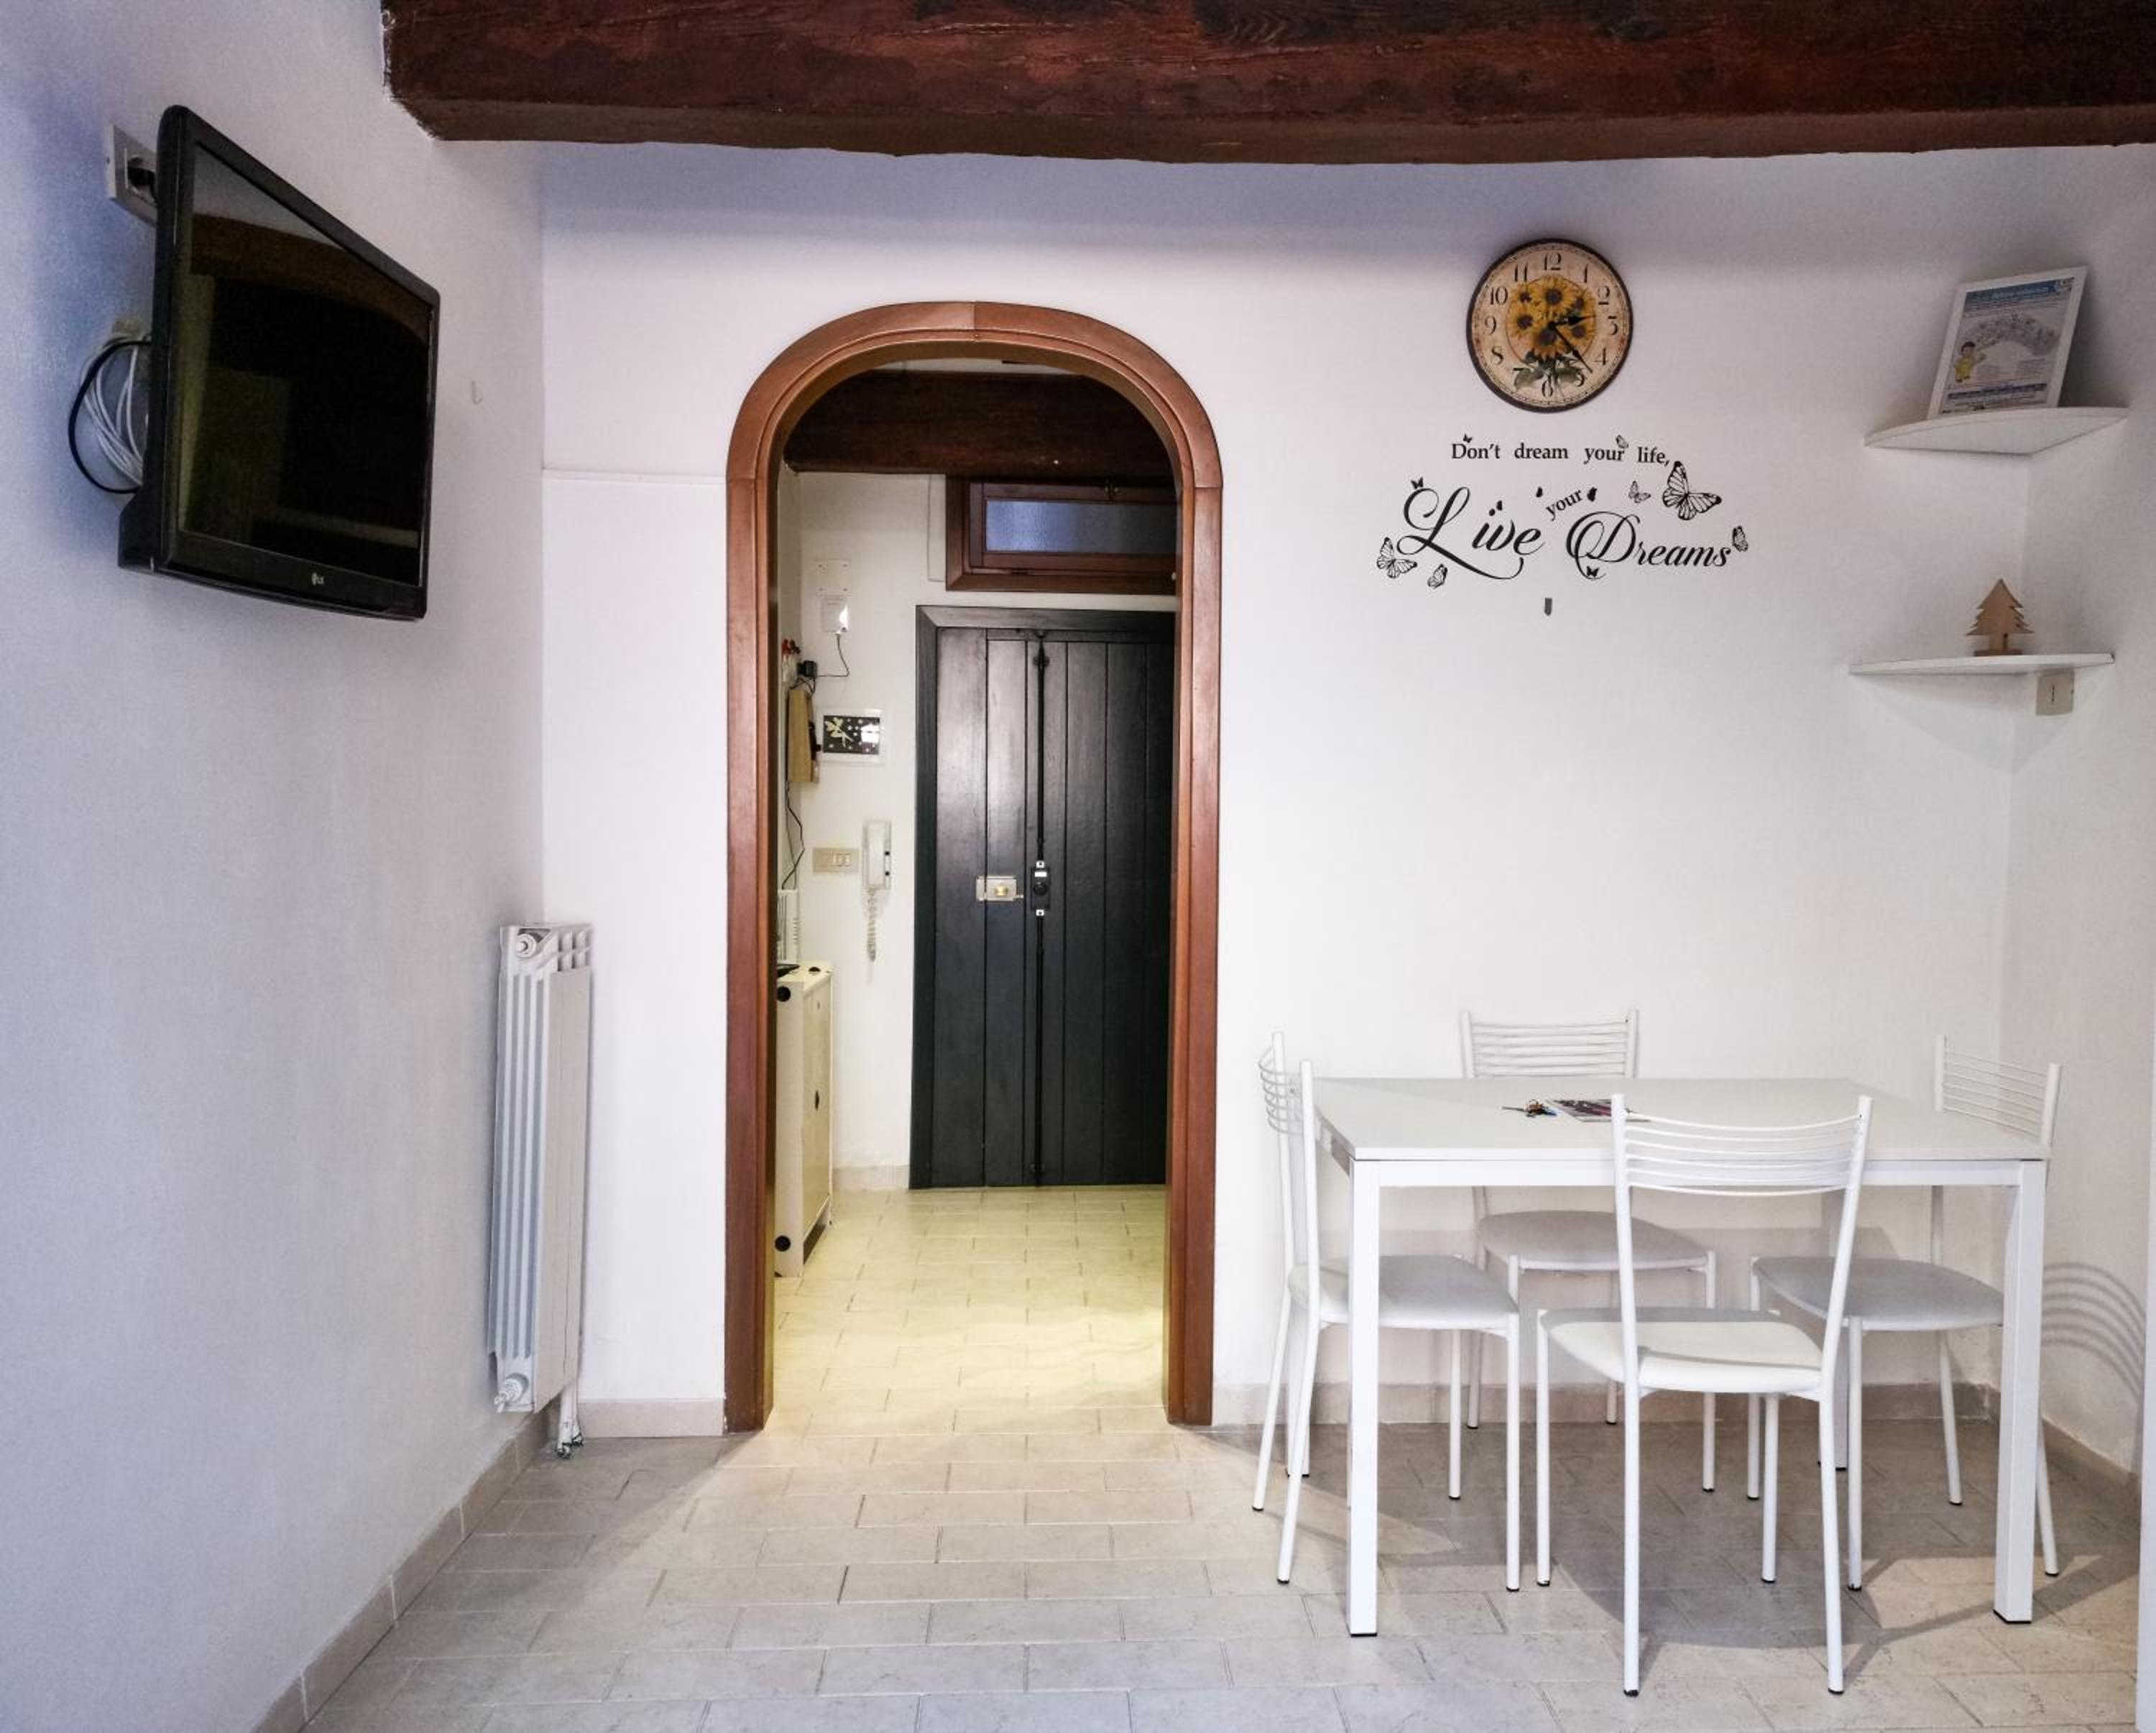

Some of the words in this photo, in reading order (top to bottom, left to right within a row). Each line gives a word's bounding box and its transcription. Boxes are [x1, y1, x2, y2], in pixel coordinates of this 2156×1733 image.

[1514, 261, 1529, 282] 11
[1543, 252, 1562, 271] 12
[1583, 263, 1590, 283] 1
[1489, 285, 1509, 305] 10
[1597, 285, 1611, 305] 2
[1484, 315, 1497, 334] 9
[1607, 315, 1618, 336] 3
[1491, 346, 1503, 364] 8
[1593, 348, 1609, 366] 4
[1542, 375, 1554, 397] 6
[1452, 443, 1501, 459] Don't
[1514, 443, 1568, 459] dream
[1584, 448, 1625, 464] your
[1638, 447, 1670, 466] life,
[1397, 486, 1544, 580] Live
[1545, 488, 1584, 520] your
[1566, 512, 1731, 580] Dreams
